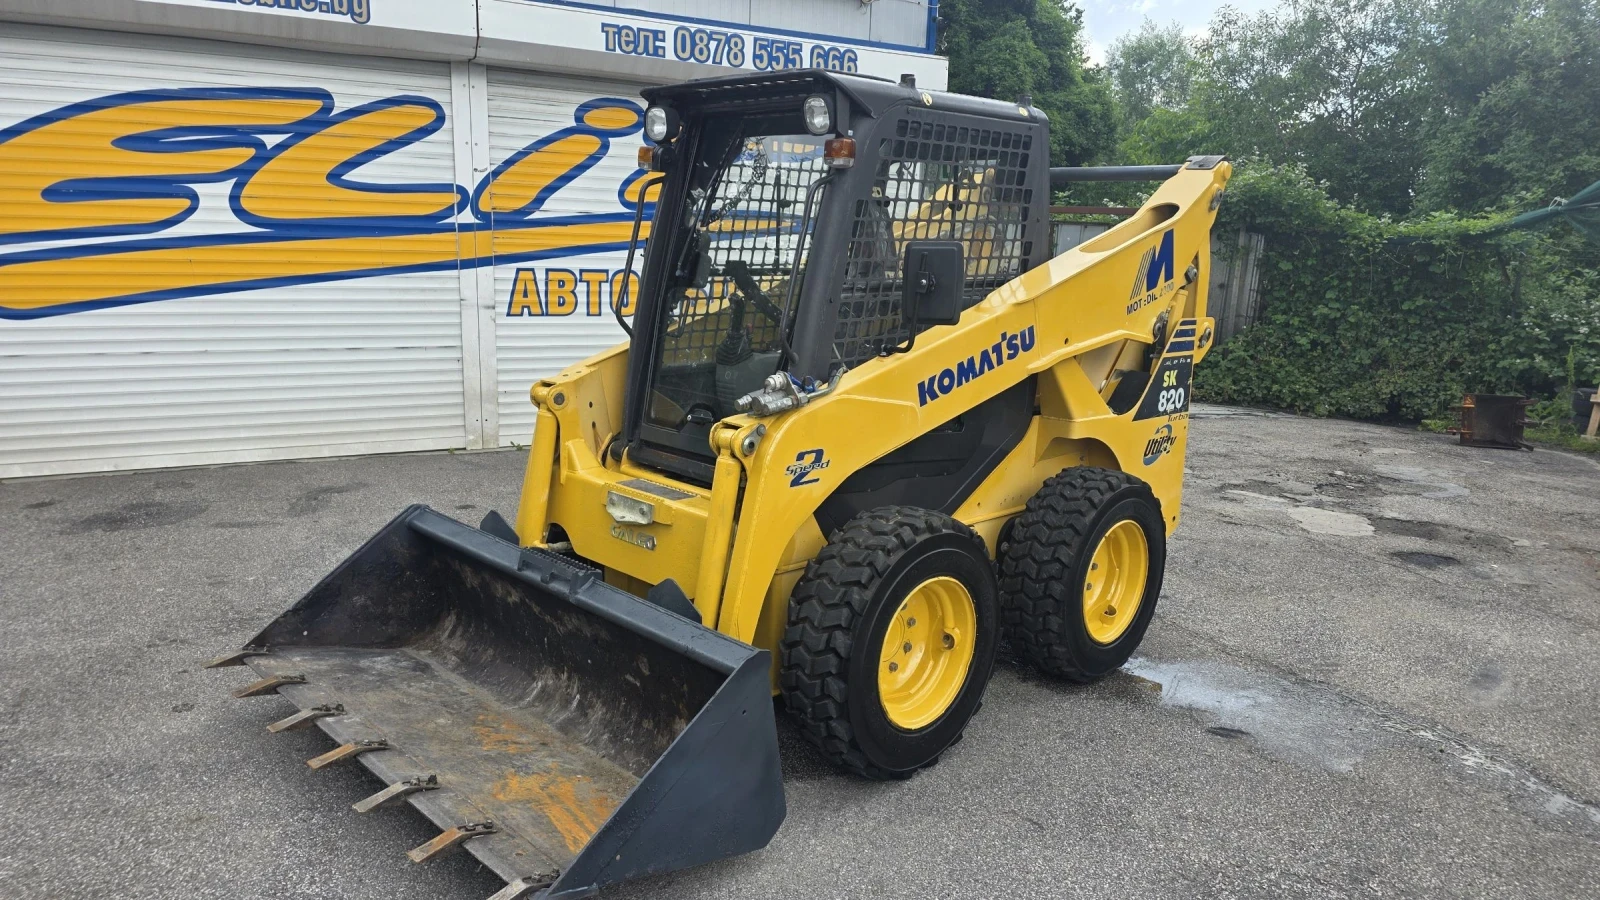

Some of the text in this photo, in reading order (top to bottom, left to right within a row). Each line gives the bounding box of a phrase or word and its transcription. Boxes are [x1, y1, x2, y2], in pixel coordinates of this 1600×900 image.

[674, 26, 745, 68] 0878
[753, 37, 802, 71] 555
[810, 45, 858, 73] 666
[917, 325, 1035, 407] KOMATSU
[1162, 369, 1178, 388] SK
[1157, 387, 1185, 412] 820
[784, 459, 830, 476] Speed
[790, 448, 824, 488] 2
